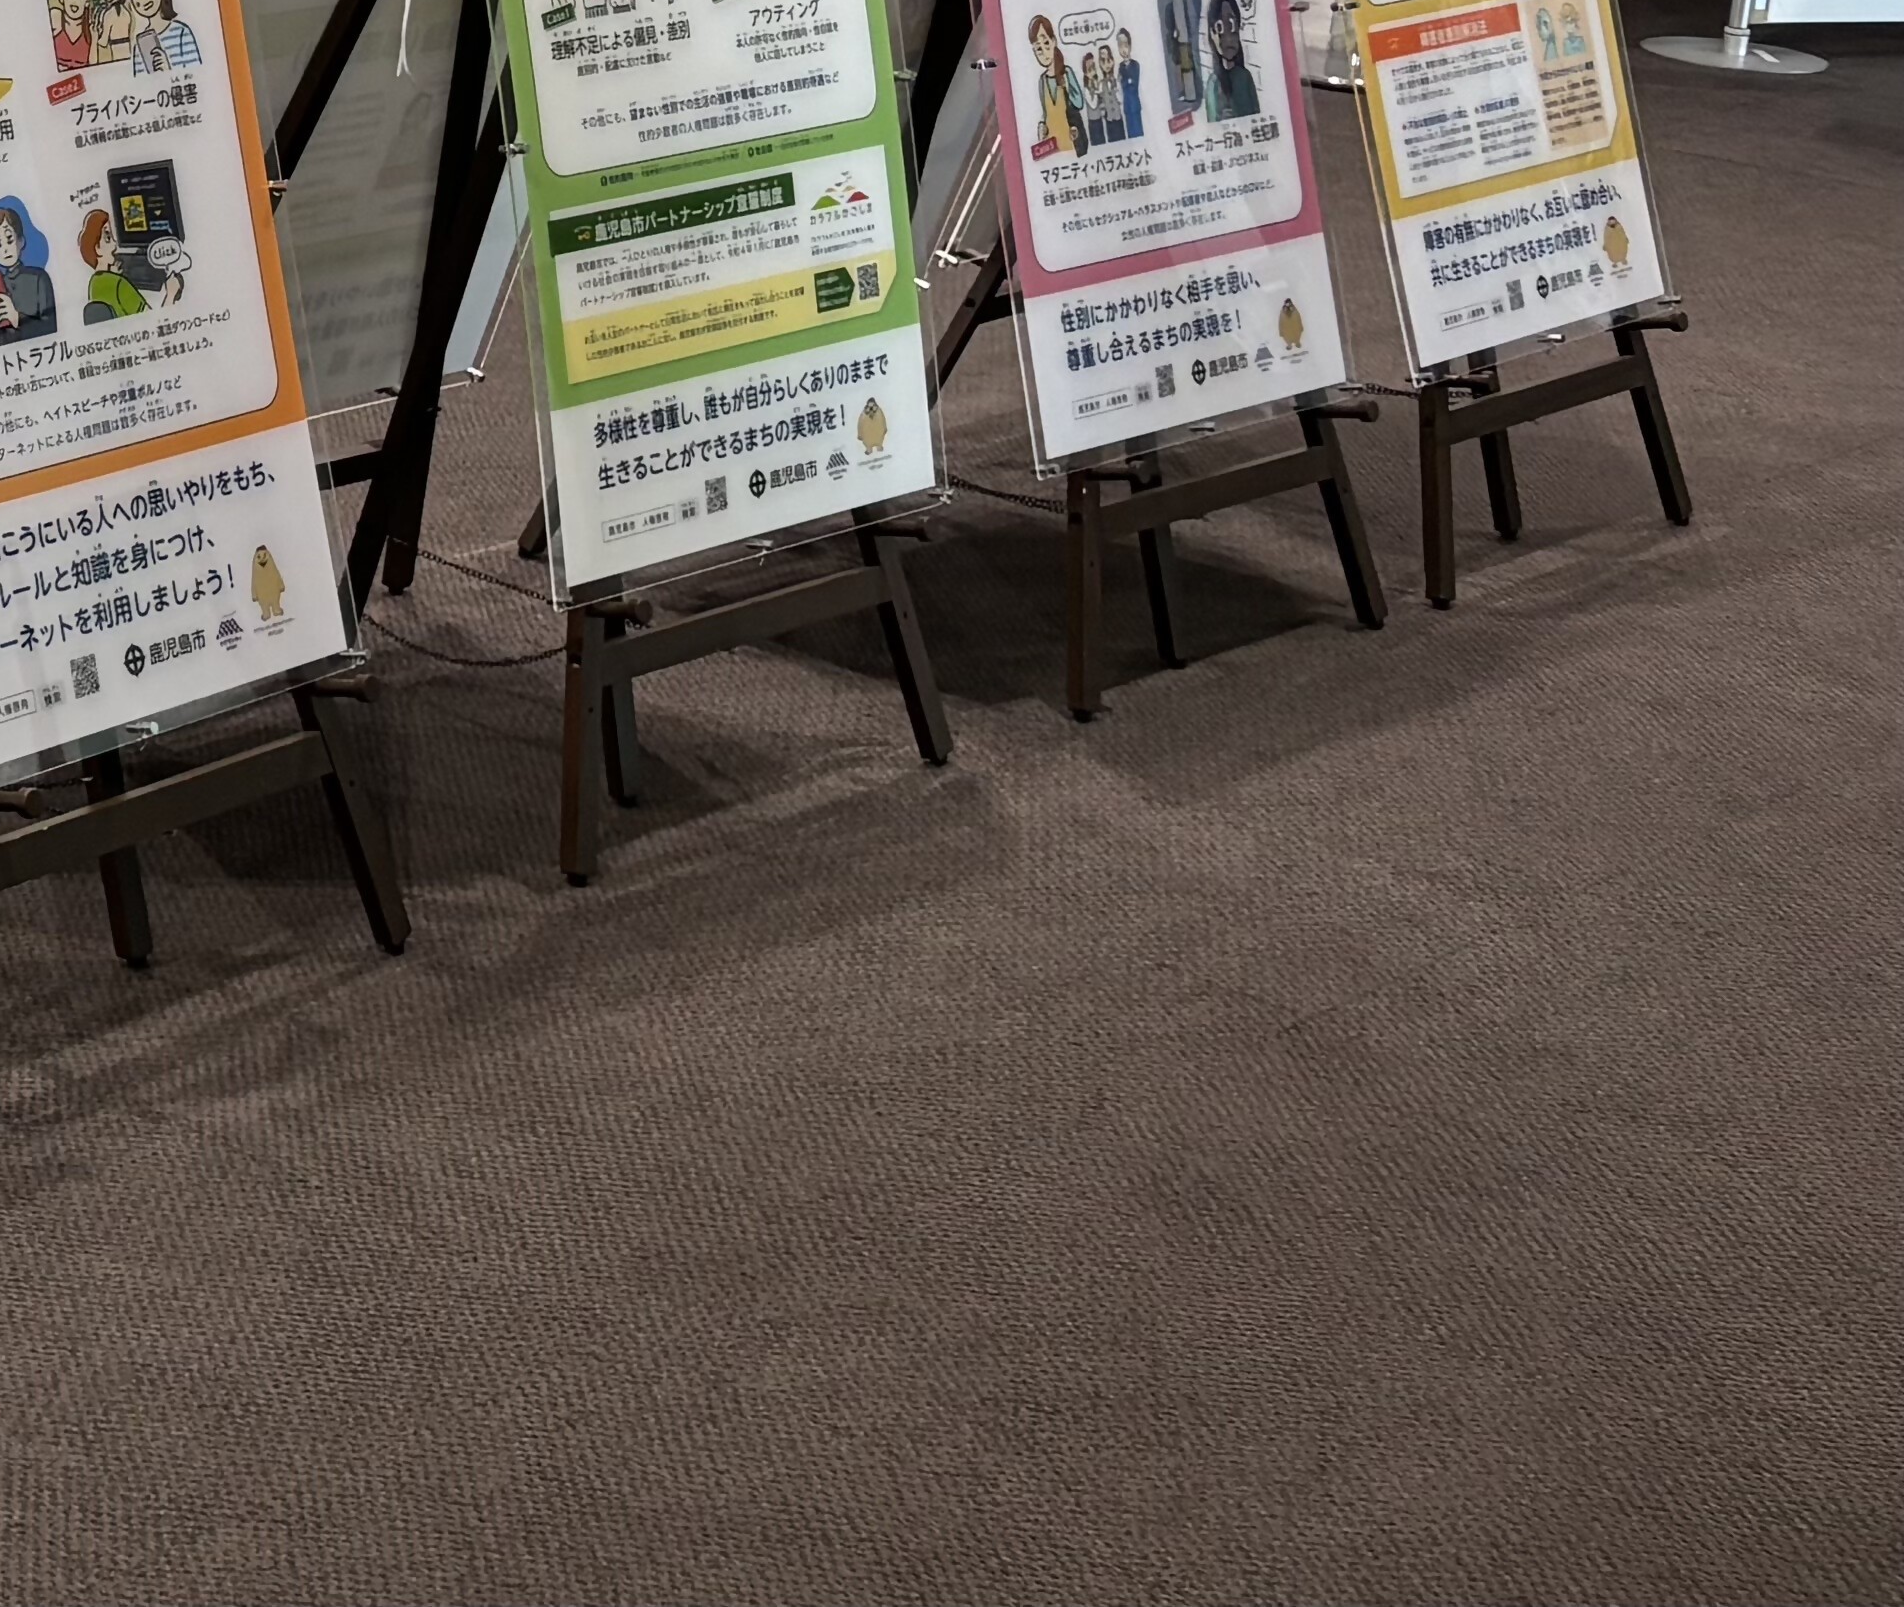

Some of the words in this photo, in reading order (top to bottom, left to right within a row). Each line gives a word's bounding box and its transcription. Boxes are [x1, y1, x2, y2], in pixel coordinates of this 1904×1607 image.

[71, 83, 198, 126] プライバシーの侵害
[1041, 148, 1152, 185] マタニティ・ハラスメント
[1061, 270, 1261, 334] 性別にかかわりなく相手を思い、
[1067, 309, 1241, 372] 尊重し合えるまちの実現を！
[594, 354, 889, 449] 多様性を尊重し、誰もが自分らしくありのままで
[598, 404, 847, 491] 生きることができるまちの実現を！
[770, 461, 818, 489] 鹿児島市
[150, 629, 206, 665] 鹿児島市
